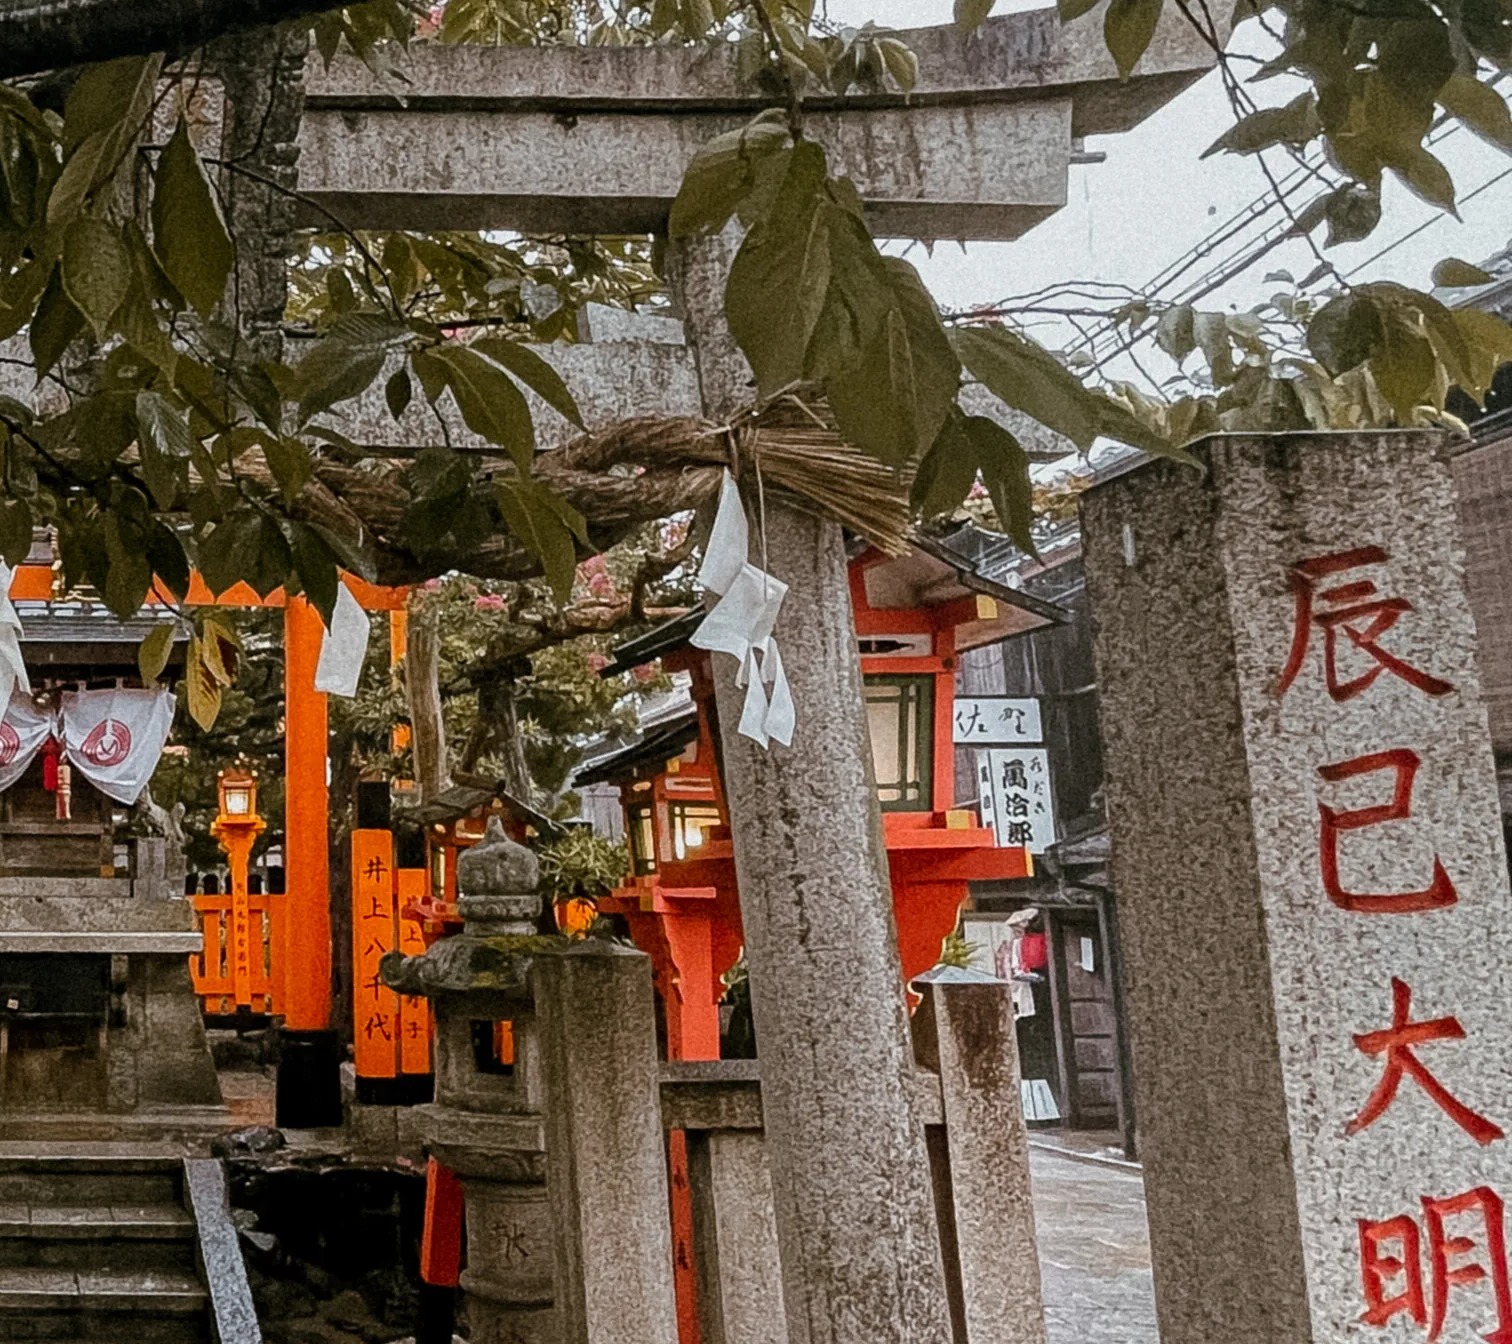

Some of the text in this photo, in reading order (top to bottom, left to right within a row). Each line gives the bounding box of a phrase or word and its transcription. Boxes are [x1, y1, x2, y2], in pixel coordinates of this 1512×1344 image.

[362, 855, 392, 1042] 井上八千代
